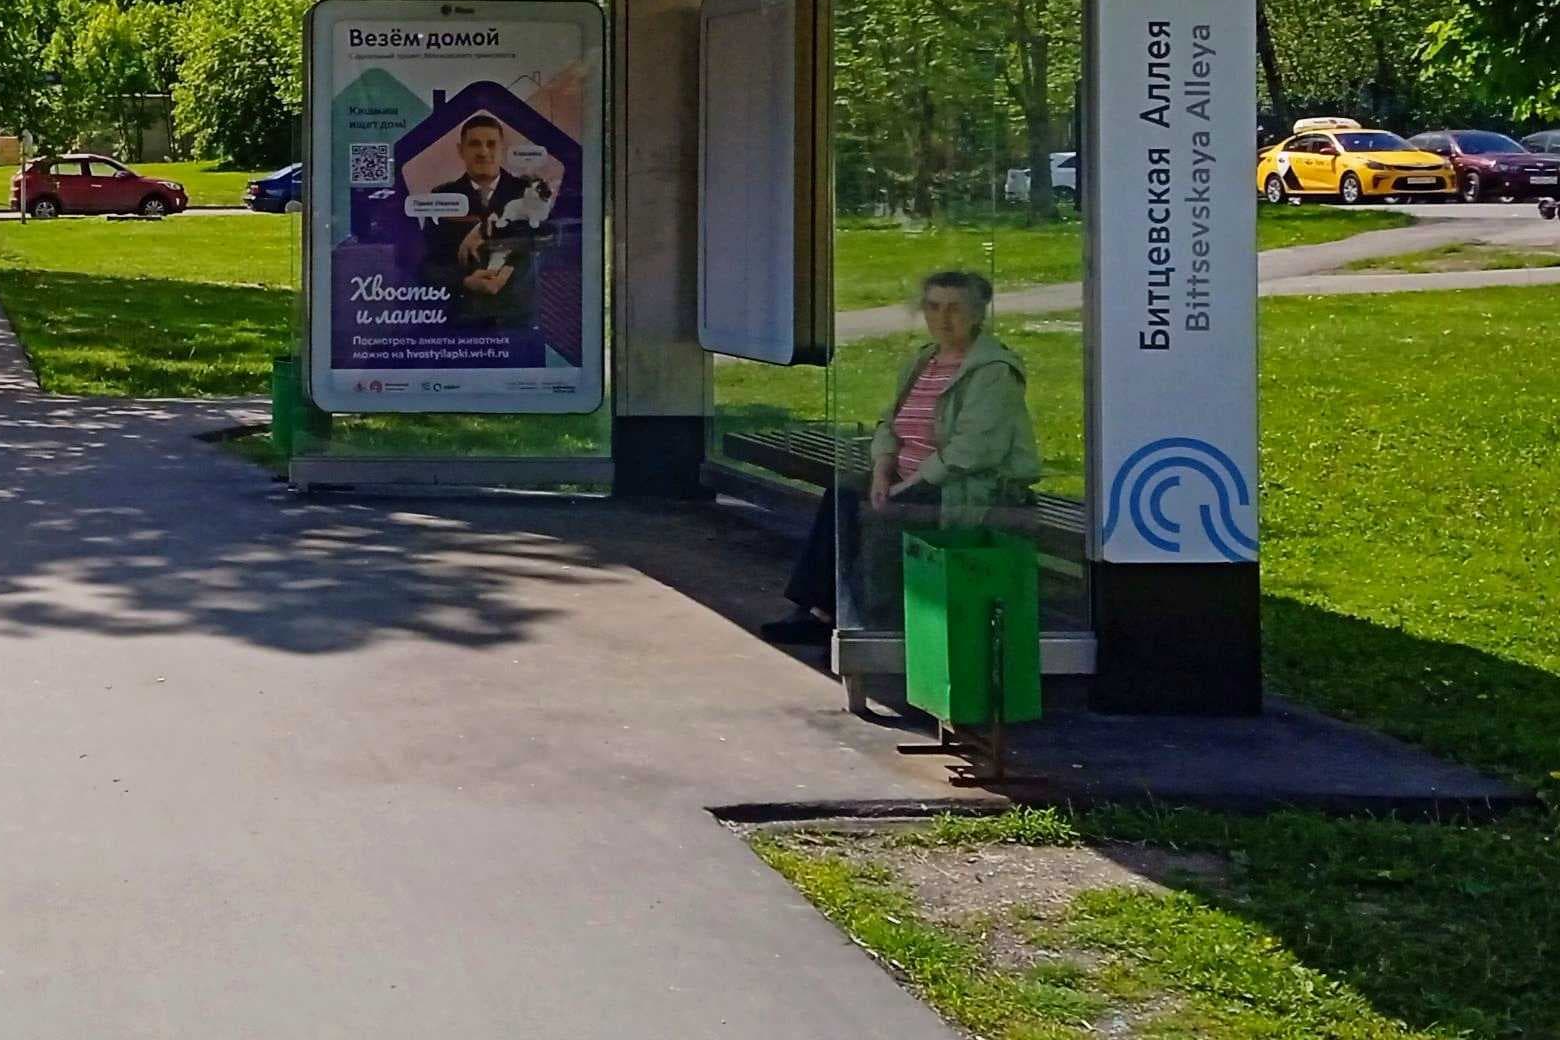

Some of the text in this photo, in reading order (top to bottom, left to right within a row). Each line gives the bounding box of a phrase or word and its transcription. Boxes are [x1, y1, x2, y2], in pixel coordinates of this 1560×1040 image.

[349, 28, 500, 49] Везём домой
[1140, 21, 1175, 351] Битцевская Аллея
[1184, 24, 1216, 332] Bittsevskaya Alleya
[350, 274, 451, 302] Хвосты
[356, 309, 448, 324] и лапки
[352, 335, 417, 346] Посмотреть
[352, 351, 389, 360] можно
[391, 351, 405, 359] на
